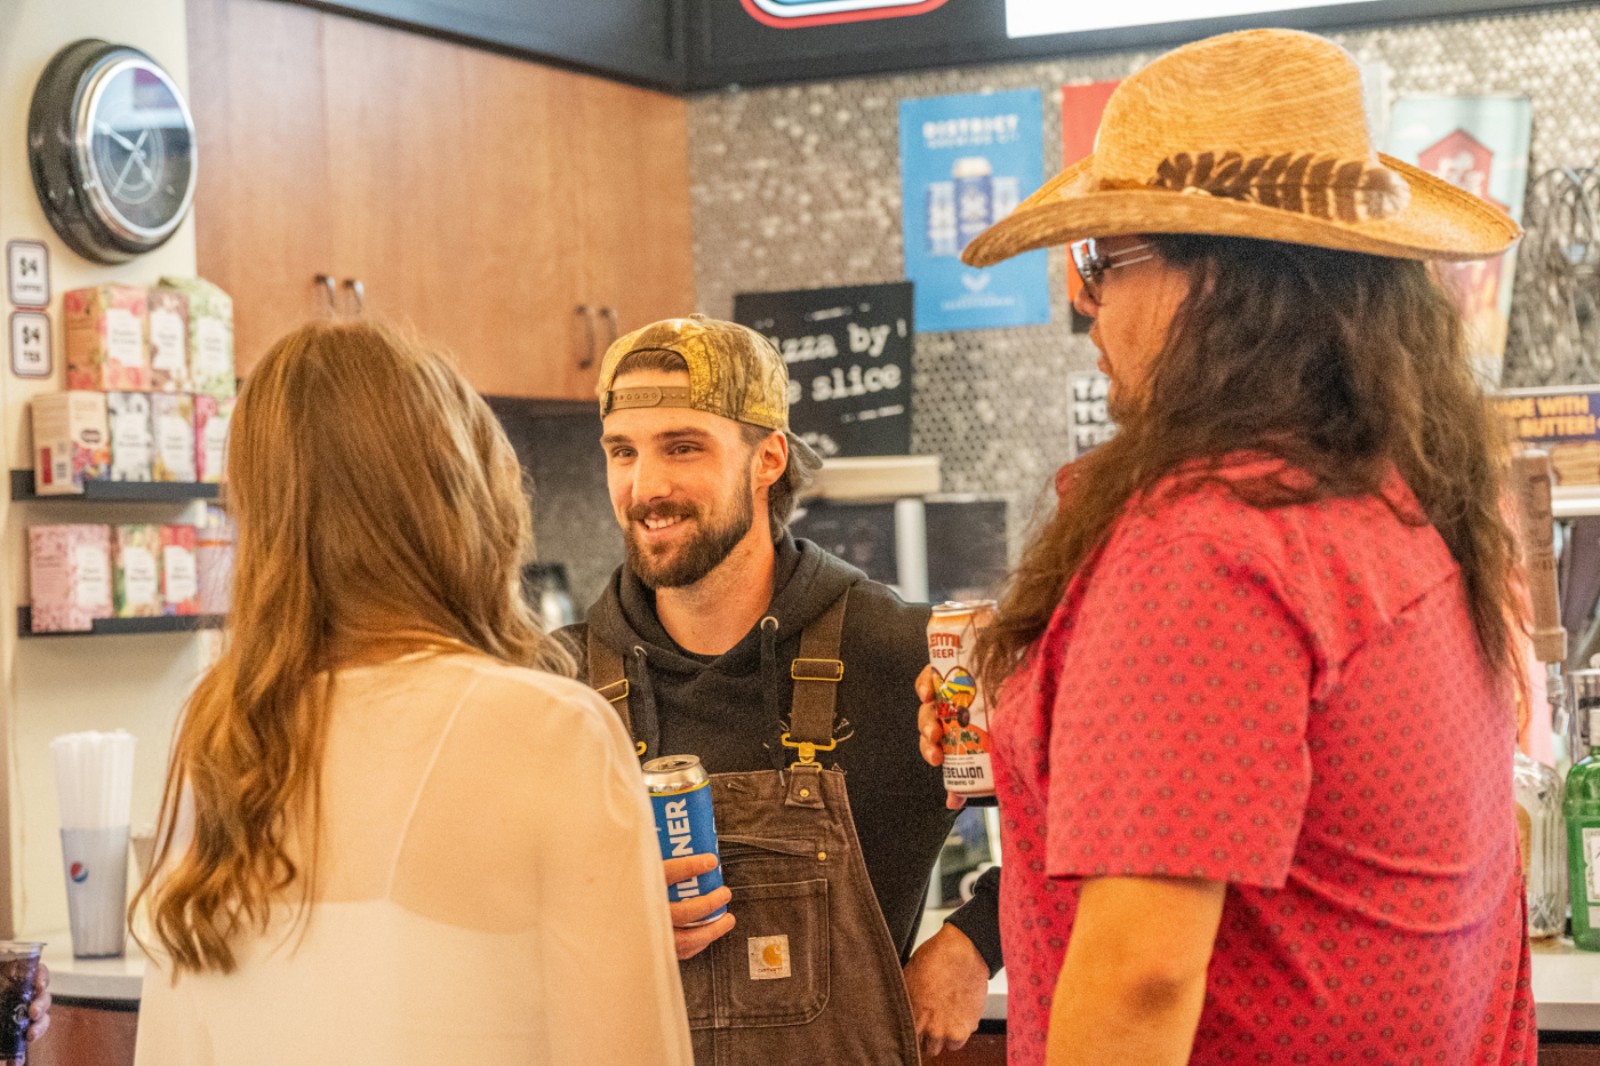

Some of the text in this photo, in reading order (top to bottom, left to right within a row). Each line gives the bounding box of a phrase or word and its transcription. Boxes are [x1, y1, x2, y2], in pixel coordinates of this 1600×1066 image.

[922, 114, 1018, 140] DISTRICT
[20, 257, 37, 277] $4
[22, 325, 40, 345] $4
[847, 322, 891, 358] by
[811, 363, 902, 402] slice
[1537, 395, 1589, 417] WITH
[931, 648, 954, 659] BEER
